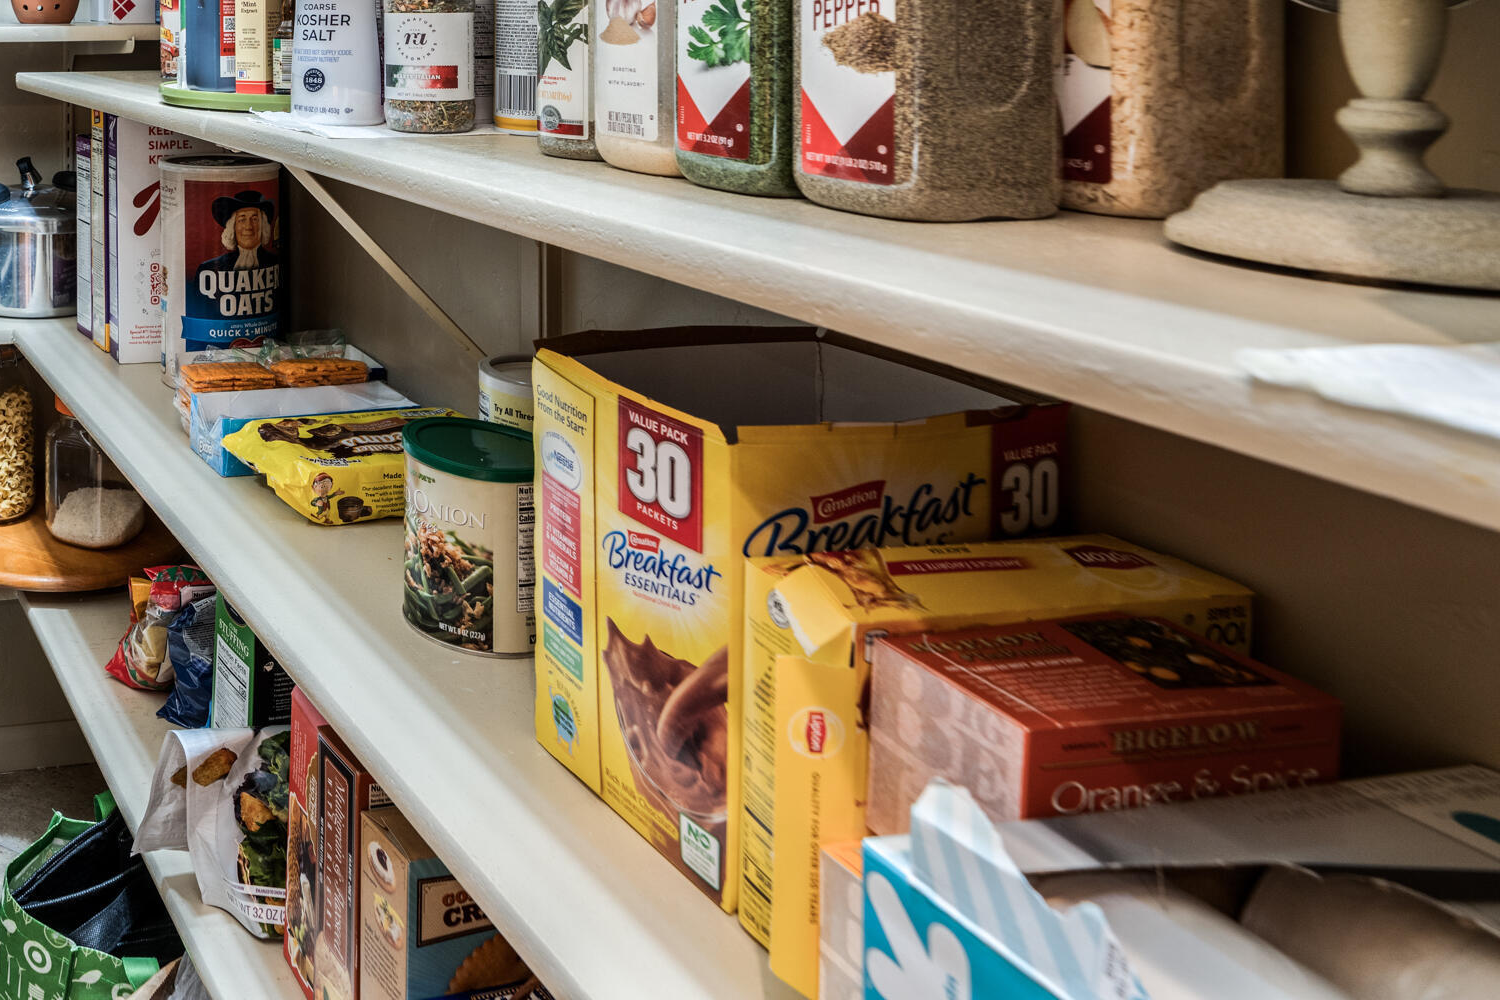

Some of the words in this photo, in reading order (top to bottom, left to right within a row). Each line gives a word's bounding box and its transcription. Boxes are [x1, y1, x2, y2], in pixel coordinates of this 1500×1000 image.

[296, 14, 351, 27] KOSHER
[304, 3, 337, 11] COARSE
[302, 29, 336, 42] SALT
[305, 76, 323, 85] 1848
[148, 139, 193, 150] SIMPLE.
[687, 131, 696, 140] NET
[696, 132, 703, 141] WT
[703, 133, 712, 143] 3.2
[711, 134, 720, 144] OZ
[806, 151, 815, 161] NET
[815, 152, 824, 162] WT
[199, 268, 280, 299] QUAKER
[219, 292, 274, 317] OATS
[209, 328, 242, 338] QUICK
[494, 403, 503, 415] Try
[504, 406, 514, 416] All
[536, 384, 554, 403] Good
[554, 394, 588, 423] Nutrition
[537, 400, 553, 417] From
[553, 409, 566, 424] the
[565, 415, 587, 436] Start
[628, 410, 660, 433] VALUE
[660, 422, 689, 446] PACK
[1003, 446, 1033, 463] VALUE
[1033, 441, 1058, 457] PACK
[383, 472, 402, 480] Made
[626, 426, 692, 520] 30
[412, 488, 487, 530] ONION
[816, 489, 879, 520] Carnation
[1000, 456, 1060, 536] 30
[636, 501, 679, 531] PACKETS
[742, 472, 987, 557] Breakfast
[629, 531, 658, 551] Carnation
[602, 529, 722, 594] Breakfast
[904, 561, 926, 573] TEA
[927, 559, 971, 571] FAVORITE
[972, 558, 1021, 570] AMERICA'S
[624, 572, 697, 607] ESSENTIALS
[219, 617, 250, 658] STUFFING
[438, 621, 447, 631] NET
[461, 628, 469, 638] OZ
[469, 630, 486, 642] (227g)
[1204, 621, 1247, 645] 100
[807, 714, 823, 752] Lipton
[1112, 719, 1261, 755] BIGELOW
[810, 772, 821, 815] QUALITY
[1050, 776, 1184, 816] Orange
[1193, 770, 1222, 797] &
[1230, 764, 1322, 798] Spice
[333, 776, 347, 864] Multigrain
[810, 818, 820, 839] FOR
[687, 821, 711, 850] NO
[809, 841, 820, 869] OVER
[325, 842, 333, 930] CRACKERS
[252, 906, 264, 919] 32
[265, 908, 279, 921] OZ
[333, 880, 347, 961] Flaxseed
[808, 890, 819, 926] YEARS
